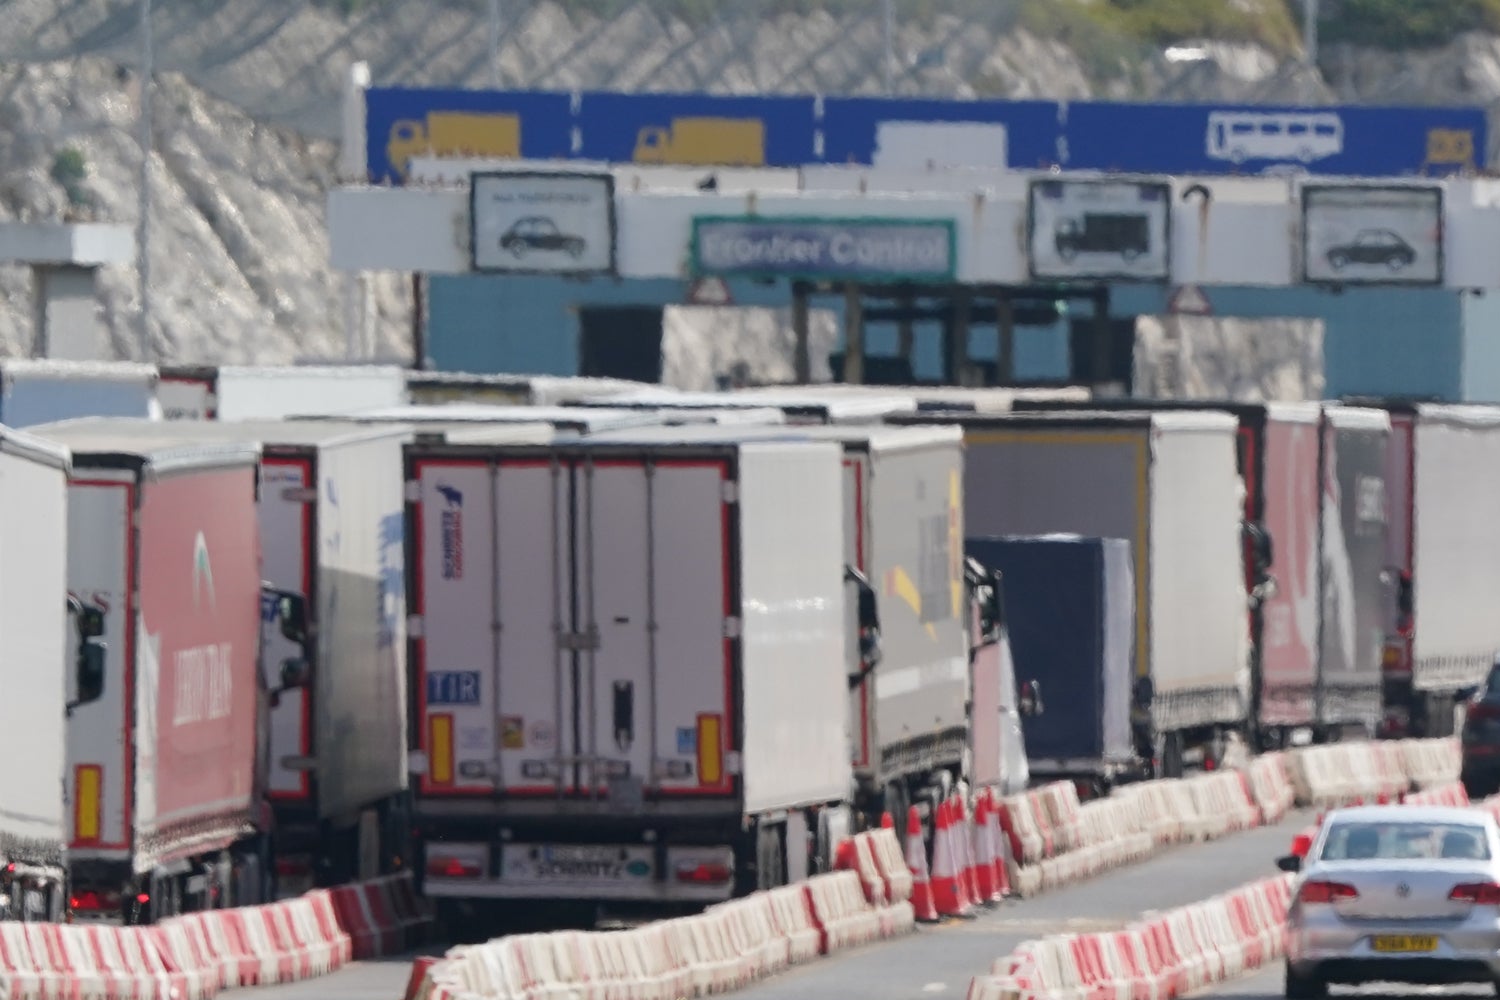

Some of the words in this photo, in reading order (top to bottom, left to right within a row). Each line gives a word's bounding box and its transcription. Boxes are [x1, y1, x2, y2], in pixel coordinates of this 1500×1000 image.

[702, 232, 821, 267] Frontier
[829, 232, 947, 271] Control
[429, 671, 477, 701] TIR
